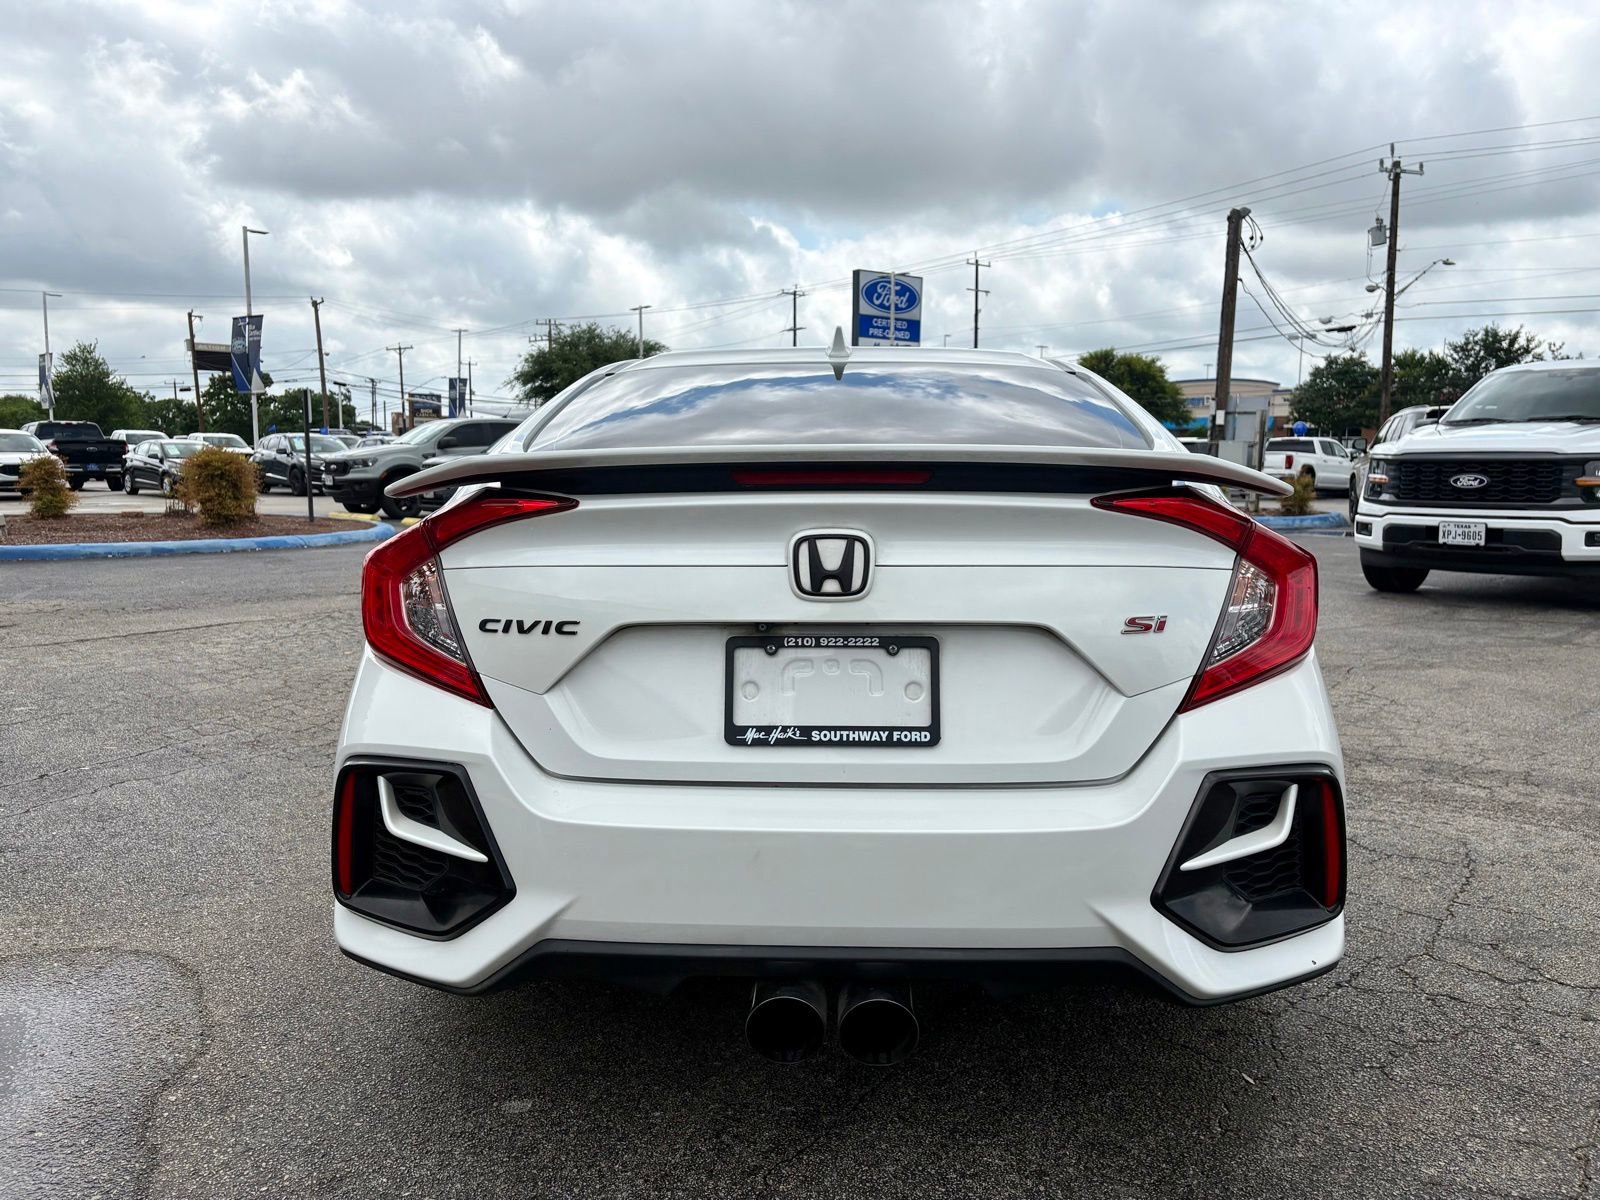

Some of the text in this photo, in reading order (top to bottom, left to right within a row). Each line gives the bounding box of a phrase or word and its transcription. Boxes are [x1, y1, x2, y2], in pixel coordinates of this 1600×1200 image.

[872, 318, 908, 329] CERTIED
[478, 618, 581, 635] CIVIC
[1121, 615, 1168, 635] Si
[783, 637, 880, 647] (210) 922-2222
[736, 726, 931, 745] Mac Haik's SOUTHWAY FORD
